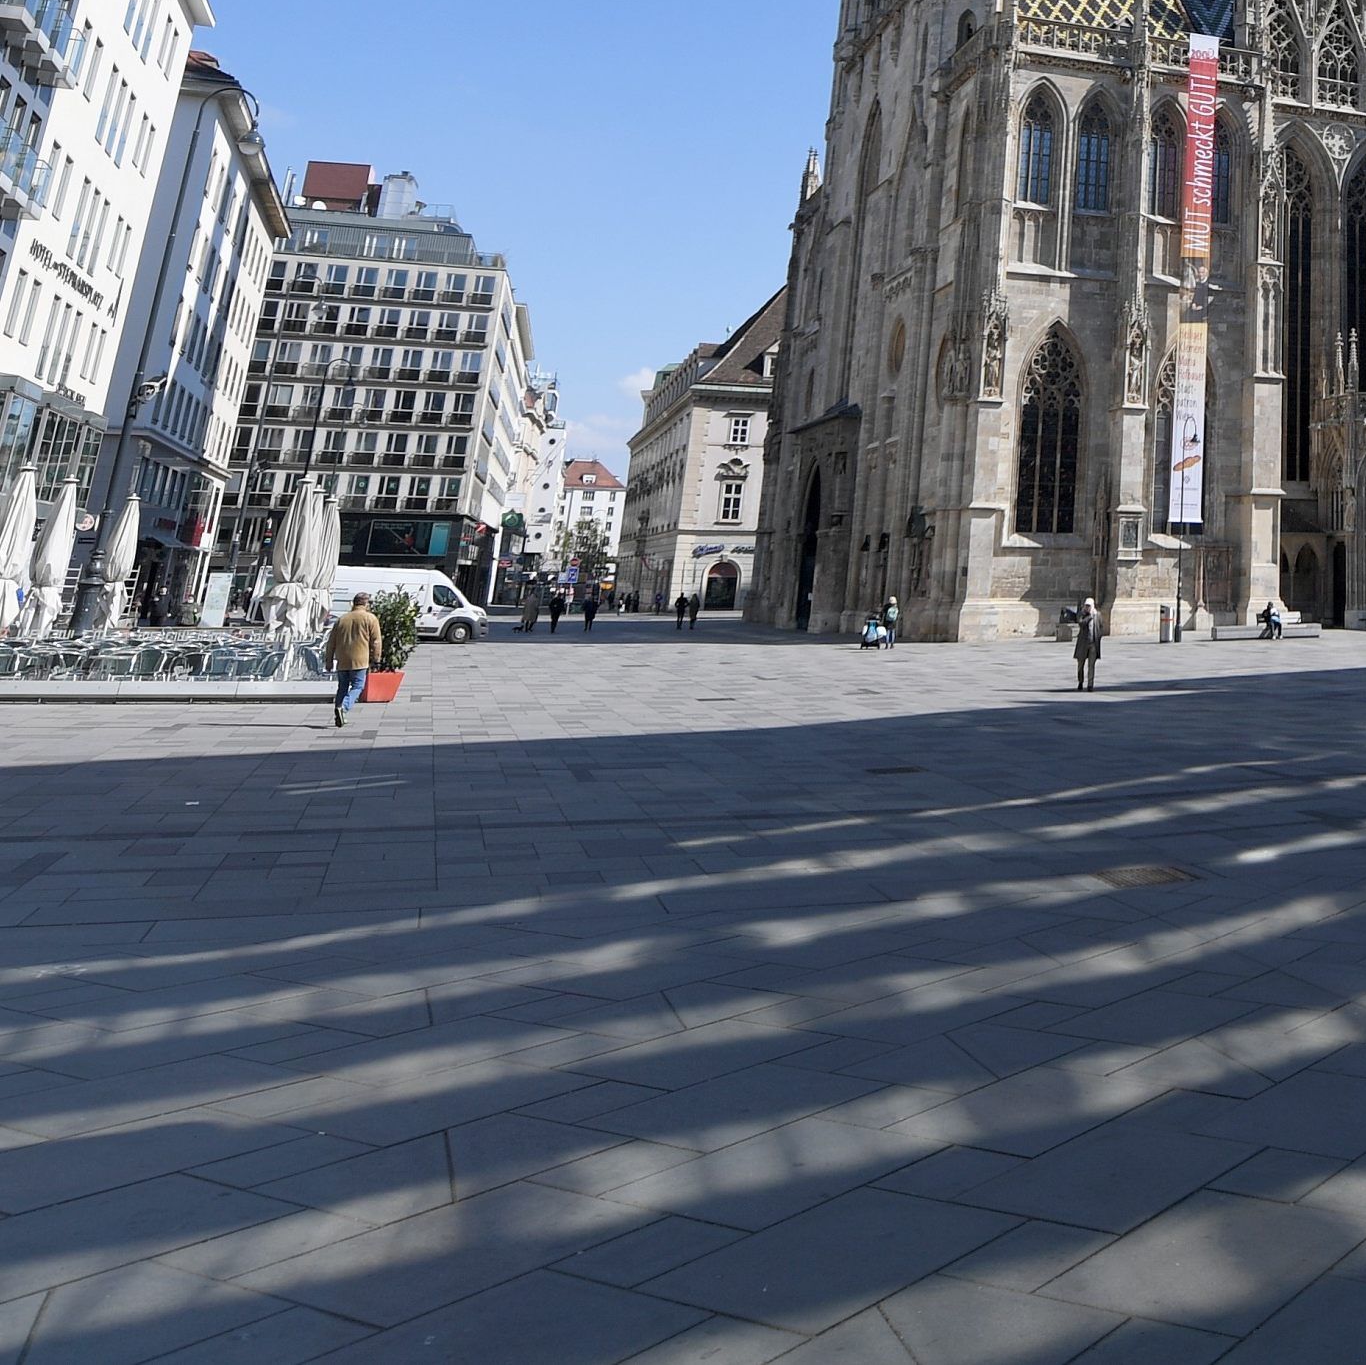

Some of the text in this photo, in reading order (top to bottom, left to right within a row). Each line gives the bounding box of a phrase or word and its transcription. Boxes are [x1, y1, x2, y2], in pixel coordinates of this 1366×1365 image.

[1184, 74, 1216, 252] MUT schmeckt GUT!
[29, 238, 53, 272] HOTEL
